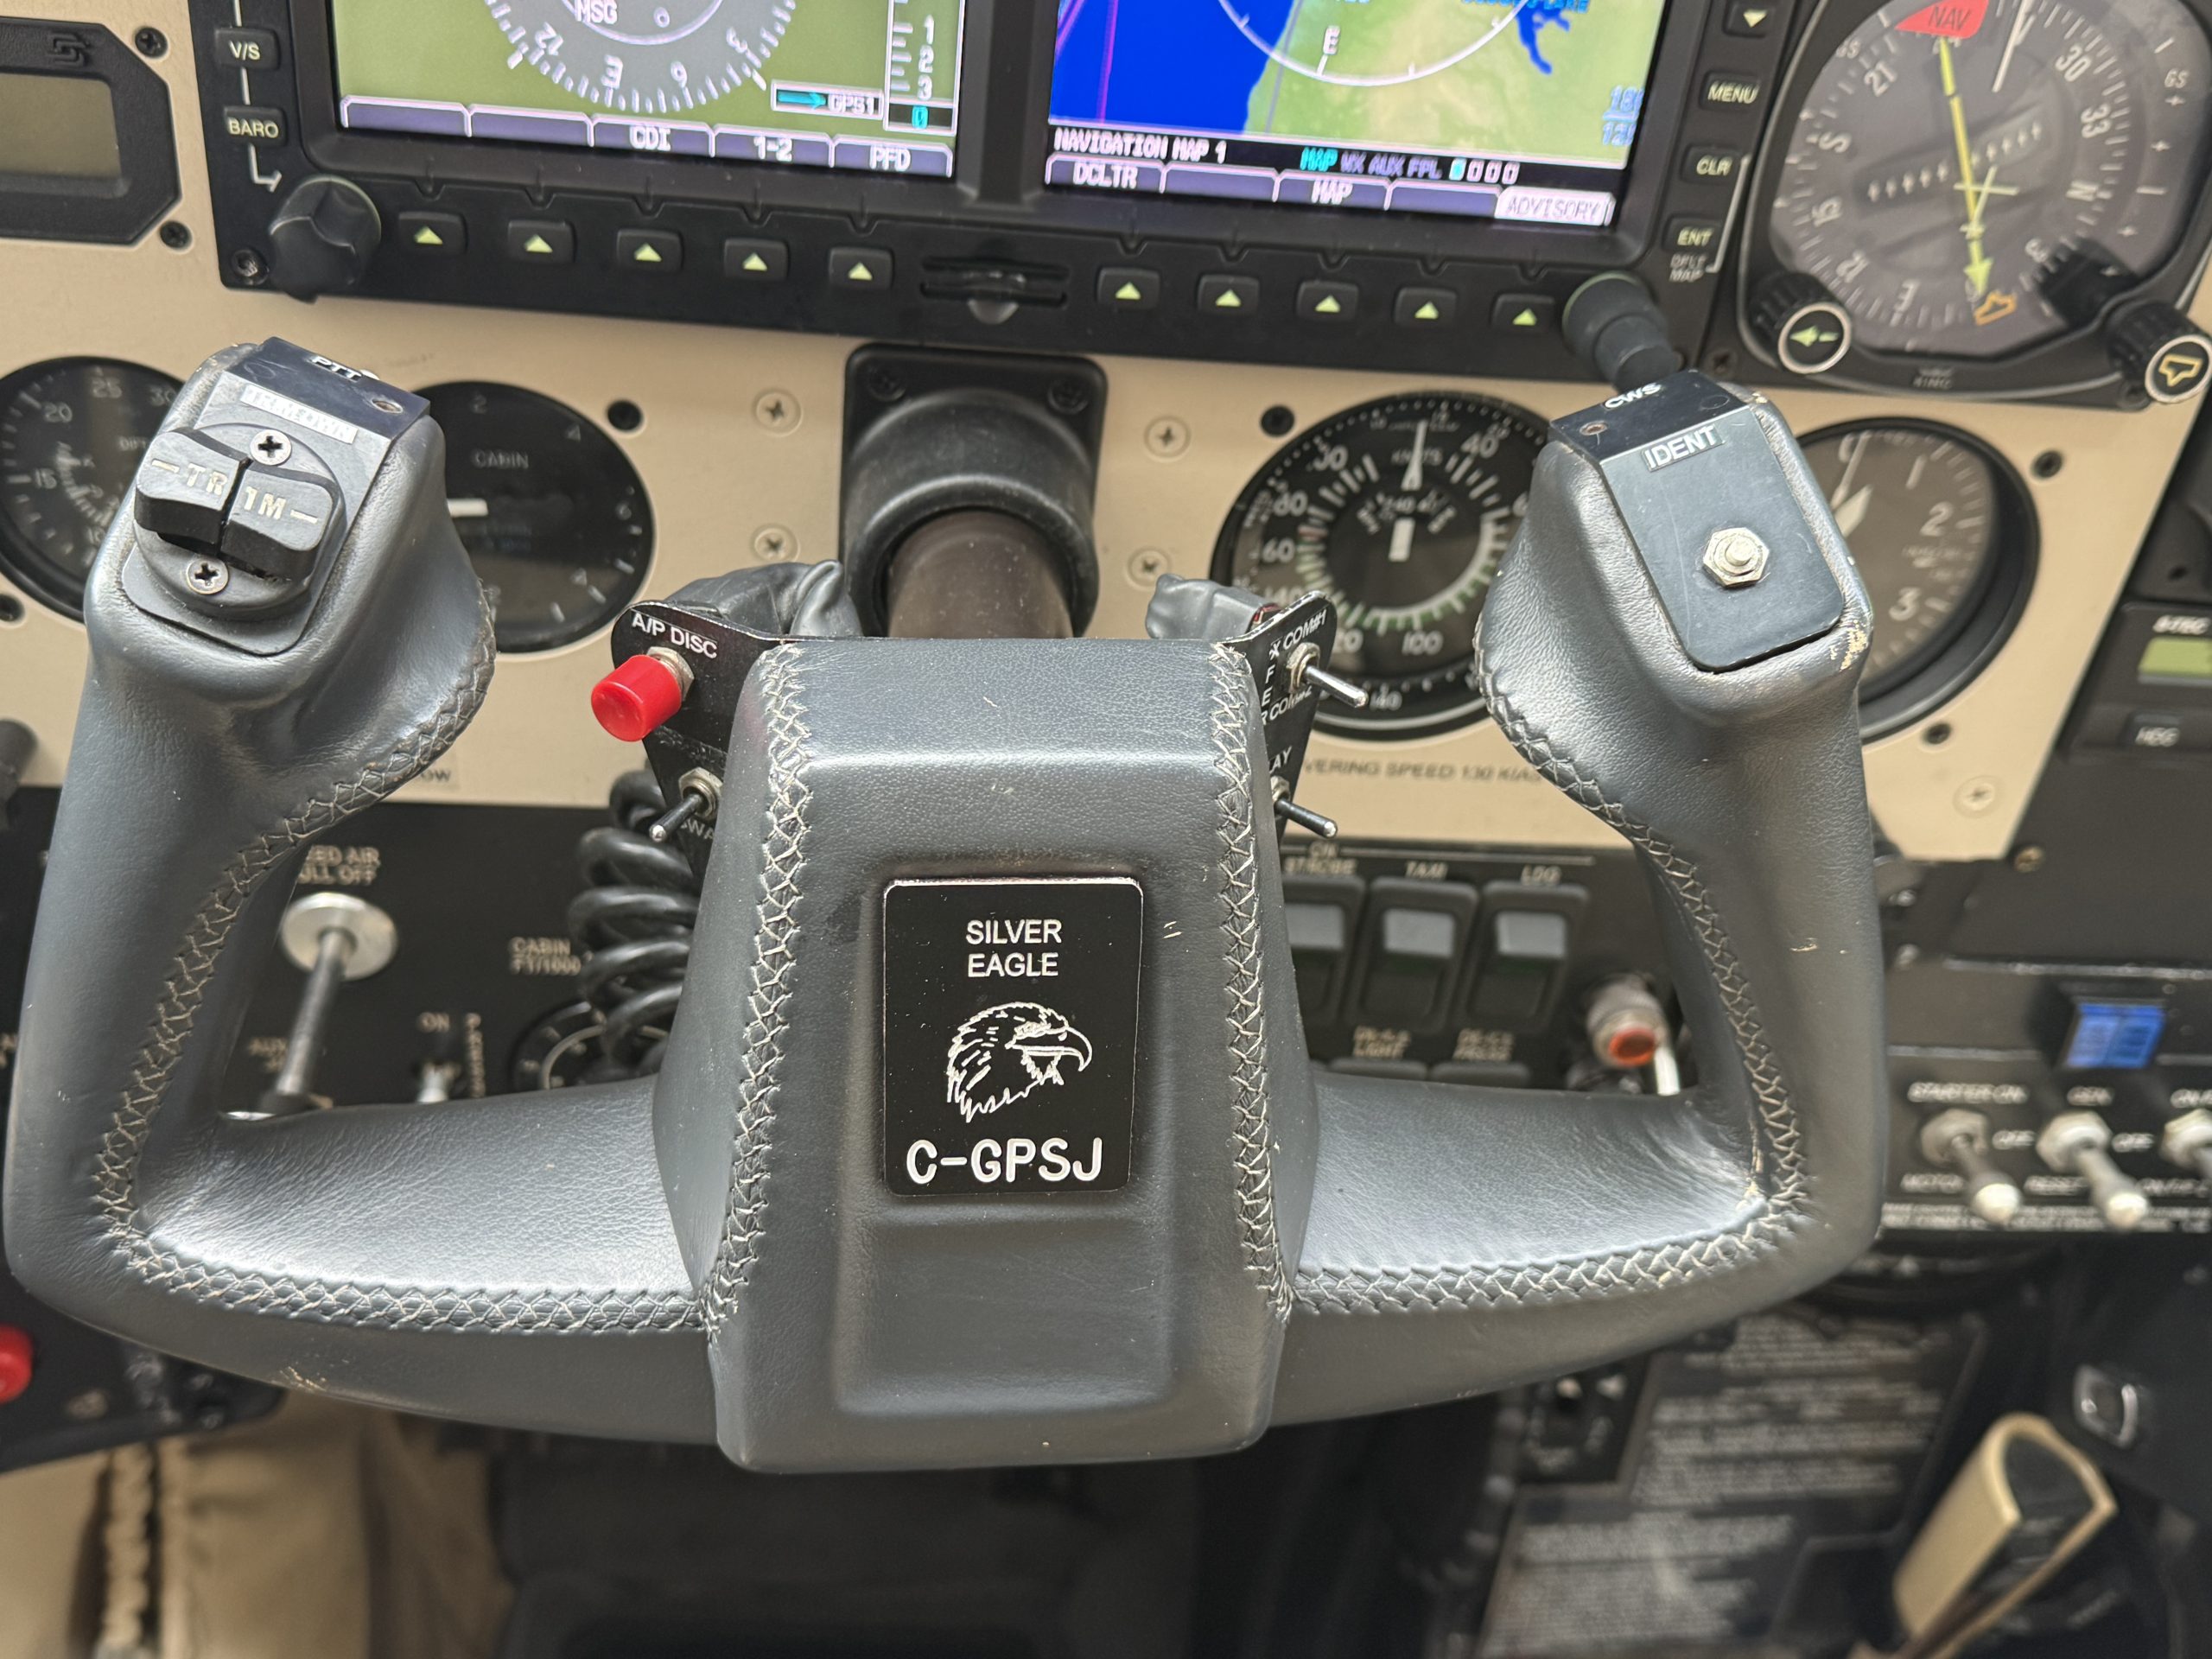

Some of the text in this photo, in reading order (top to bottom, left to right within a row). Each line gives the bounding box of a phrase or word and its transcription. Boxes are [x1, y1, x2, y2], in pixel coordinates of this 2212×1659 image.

[1928, 6, 1972, 29] NAV
[229, 41, 261, 60] V/S
[1323, 25, 1340, 54] E
[918, 45, 934, 73] 2
[2055, 45, 2092, 82] 30
[918, 74, 933, 101] 3
[1864, 60, 1898, 97] 21
[2164, 70, 2190, 89] GS
[1707, 81, 1759, 104] MENU
[228, 118, 279, 139] BARO
[2081, 104, 2111, 139] 33
[629, 125, 671, 151] CDI
[753, 136, 792, 162] 1-2
[1054, 127, 1168, 159] NAVIGATION
[1819, 132, 1852, 154] S
[869, 146, 911, 172] PFD
[1696, 156, 1732, 176] CLR
[1072, 162, 1139, 189] DCLTR
[1506, 196, 1599, 223] ADVISORY
[1677, 227, 1713, 246] ENT
[312, 355, 362, 381] PTT
[1604, 383, 1662, 410] CWS
[43, 401, 73, 423] 20
[1643, 424, 1722, 469] IDENT
[1920, 501, 1954, 537] 2
[1888, 587, 1922, 621] 3
[632, 613, 717, 659] A/P DISC
[1402, 631, 1442, 654] 100
[1386, 761, 1456, 780] SPEED
[965, 918, 1062, 945] SILVER
[510, 937, 571, 956] CABIN
[968, 952, 1059, 978] EAGLE
[418, 1012, 451, 1033] ON
[906, 1137, 1103, 1184] C-GPSJ
